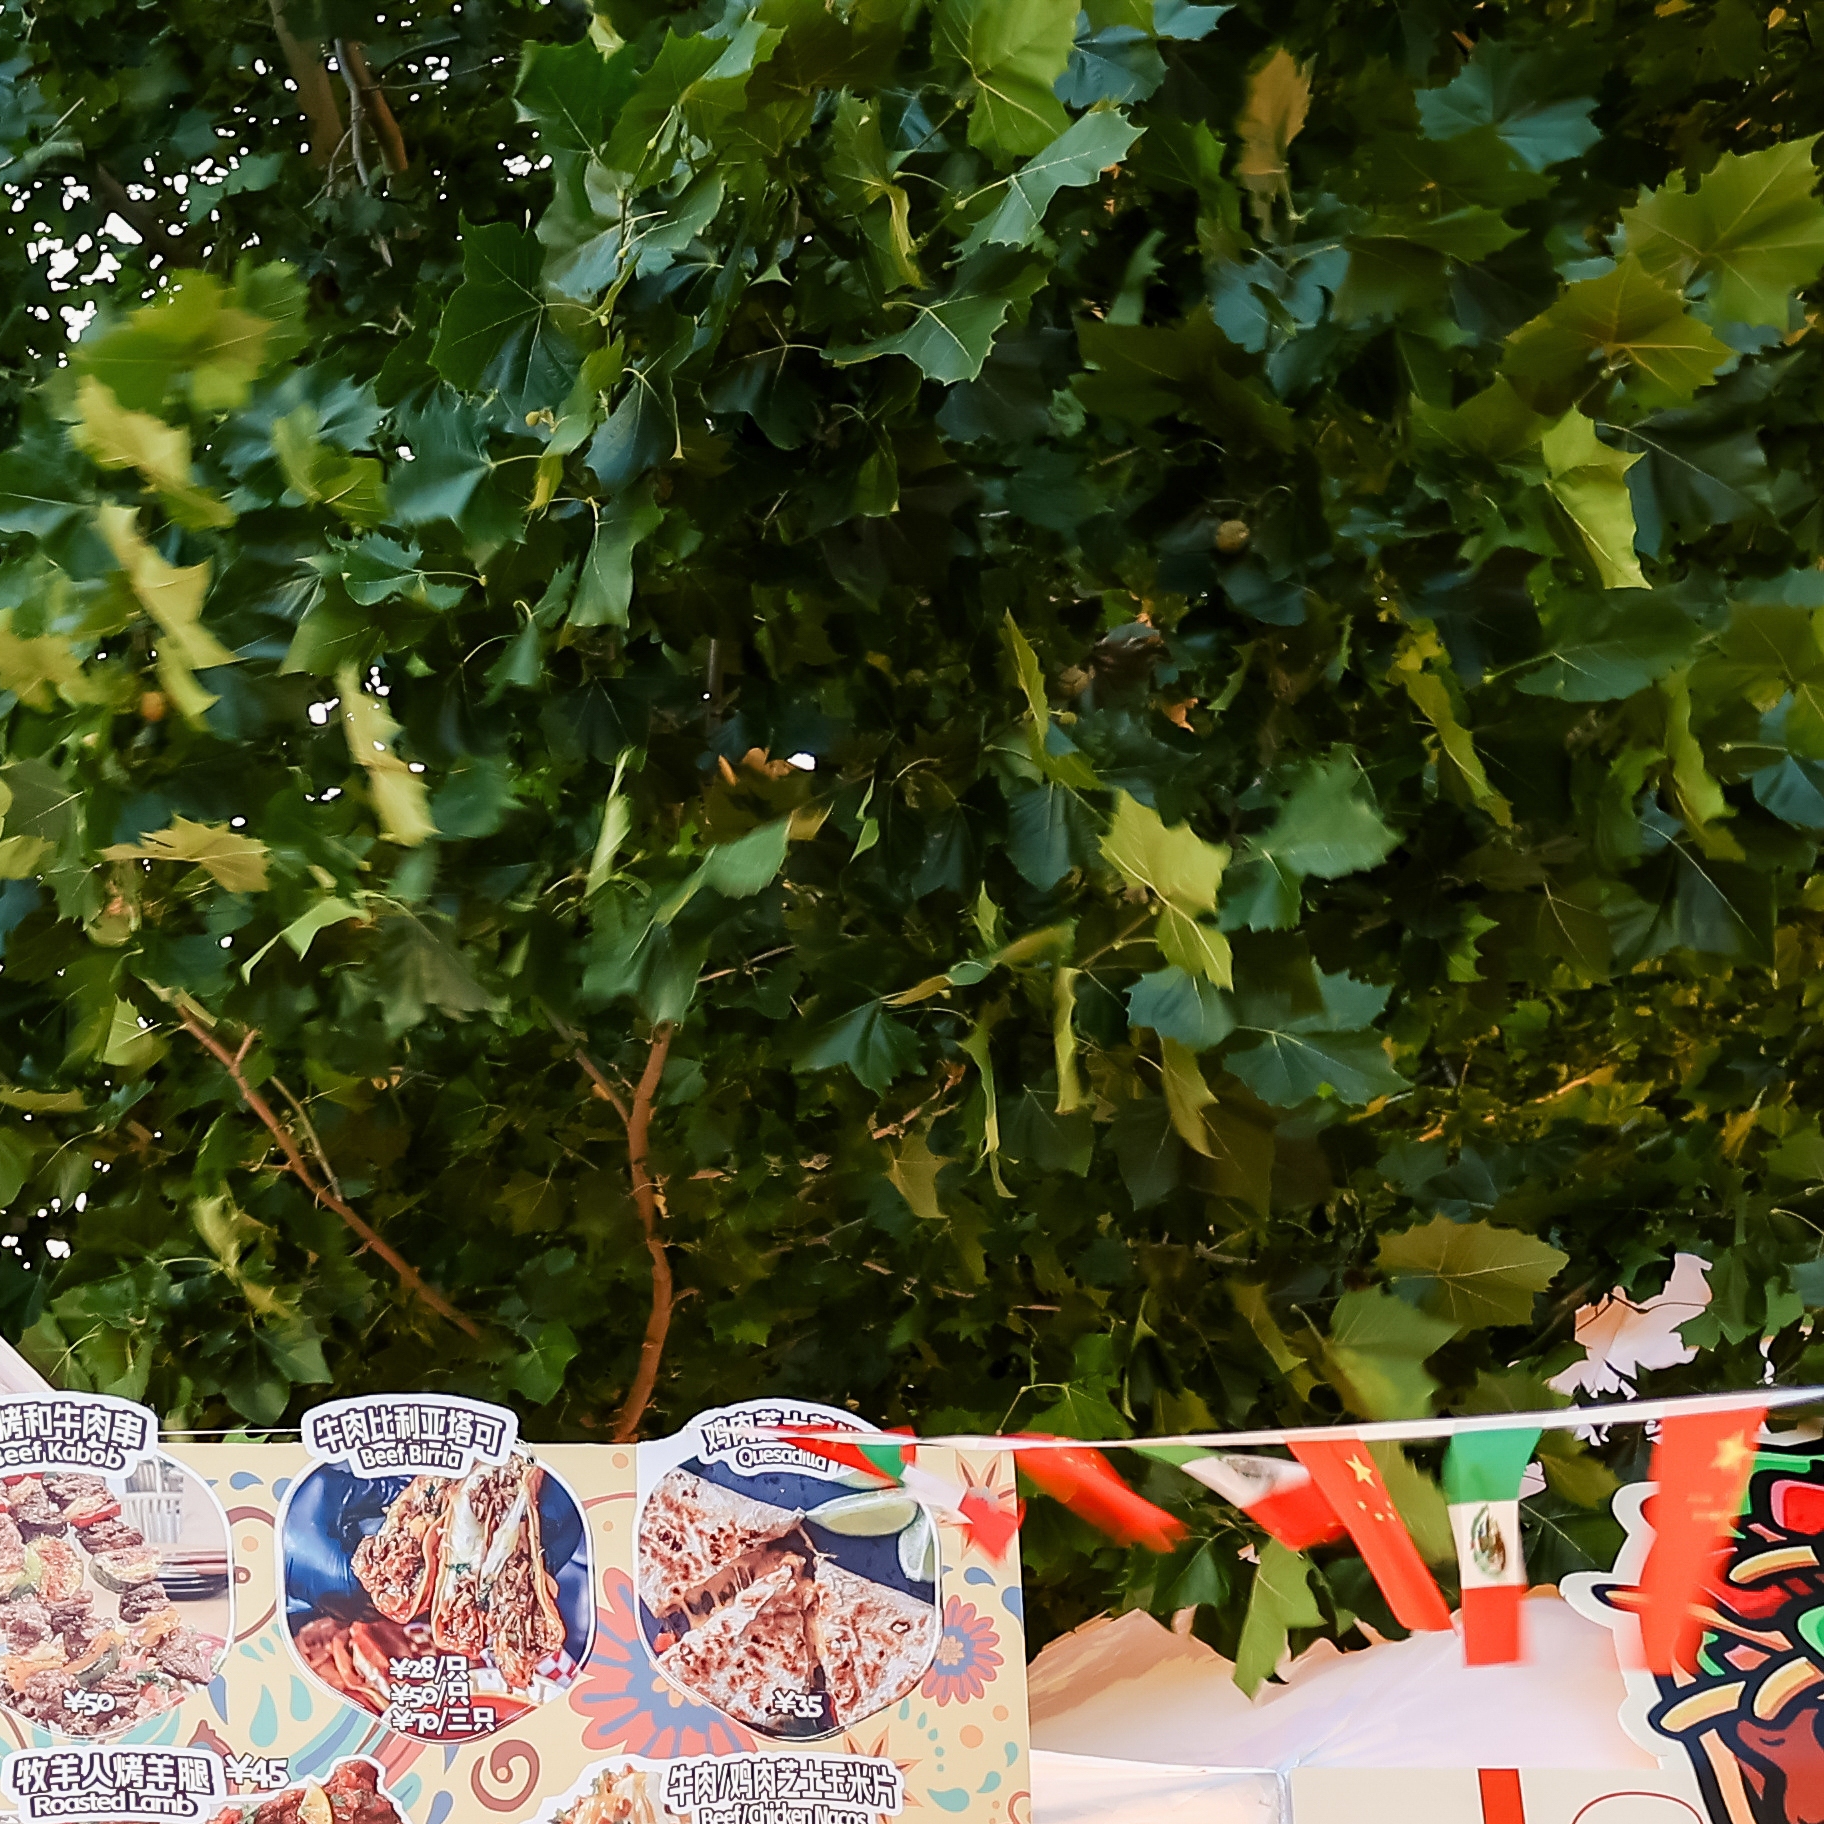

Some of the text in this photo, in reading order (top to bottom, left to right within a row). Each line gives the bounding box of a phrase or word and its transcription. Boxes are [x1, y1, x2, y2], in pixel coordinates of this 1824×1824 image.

[316, 1404, 506, 1456] 牛肉比利亚塔可
[47, 1445, 124, 1472] Kabob
[360, 1446, 463, 1471] Beef Birria
[388, 1655, 469, 1681] ¥28/只
[63, 1688, 116, 1716] ¥50
[390, 1681, 469, 1707] ¥50/只
[773, 1690, 824, 1718] ¥35
[15, 1755, 290, 1797] 牧羊人烤羊腿 ¥45
[667, 1757, 899, 1808] 牛肉/鸡肉芝士玉米片
[32, 1791, 198, 1817] Roasted Lamb
